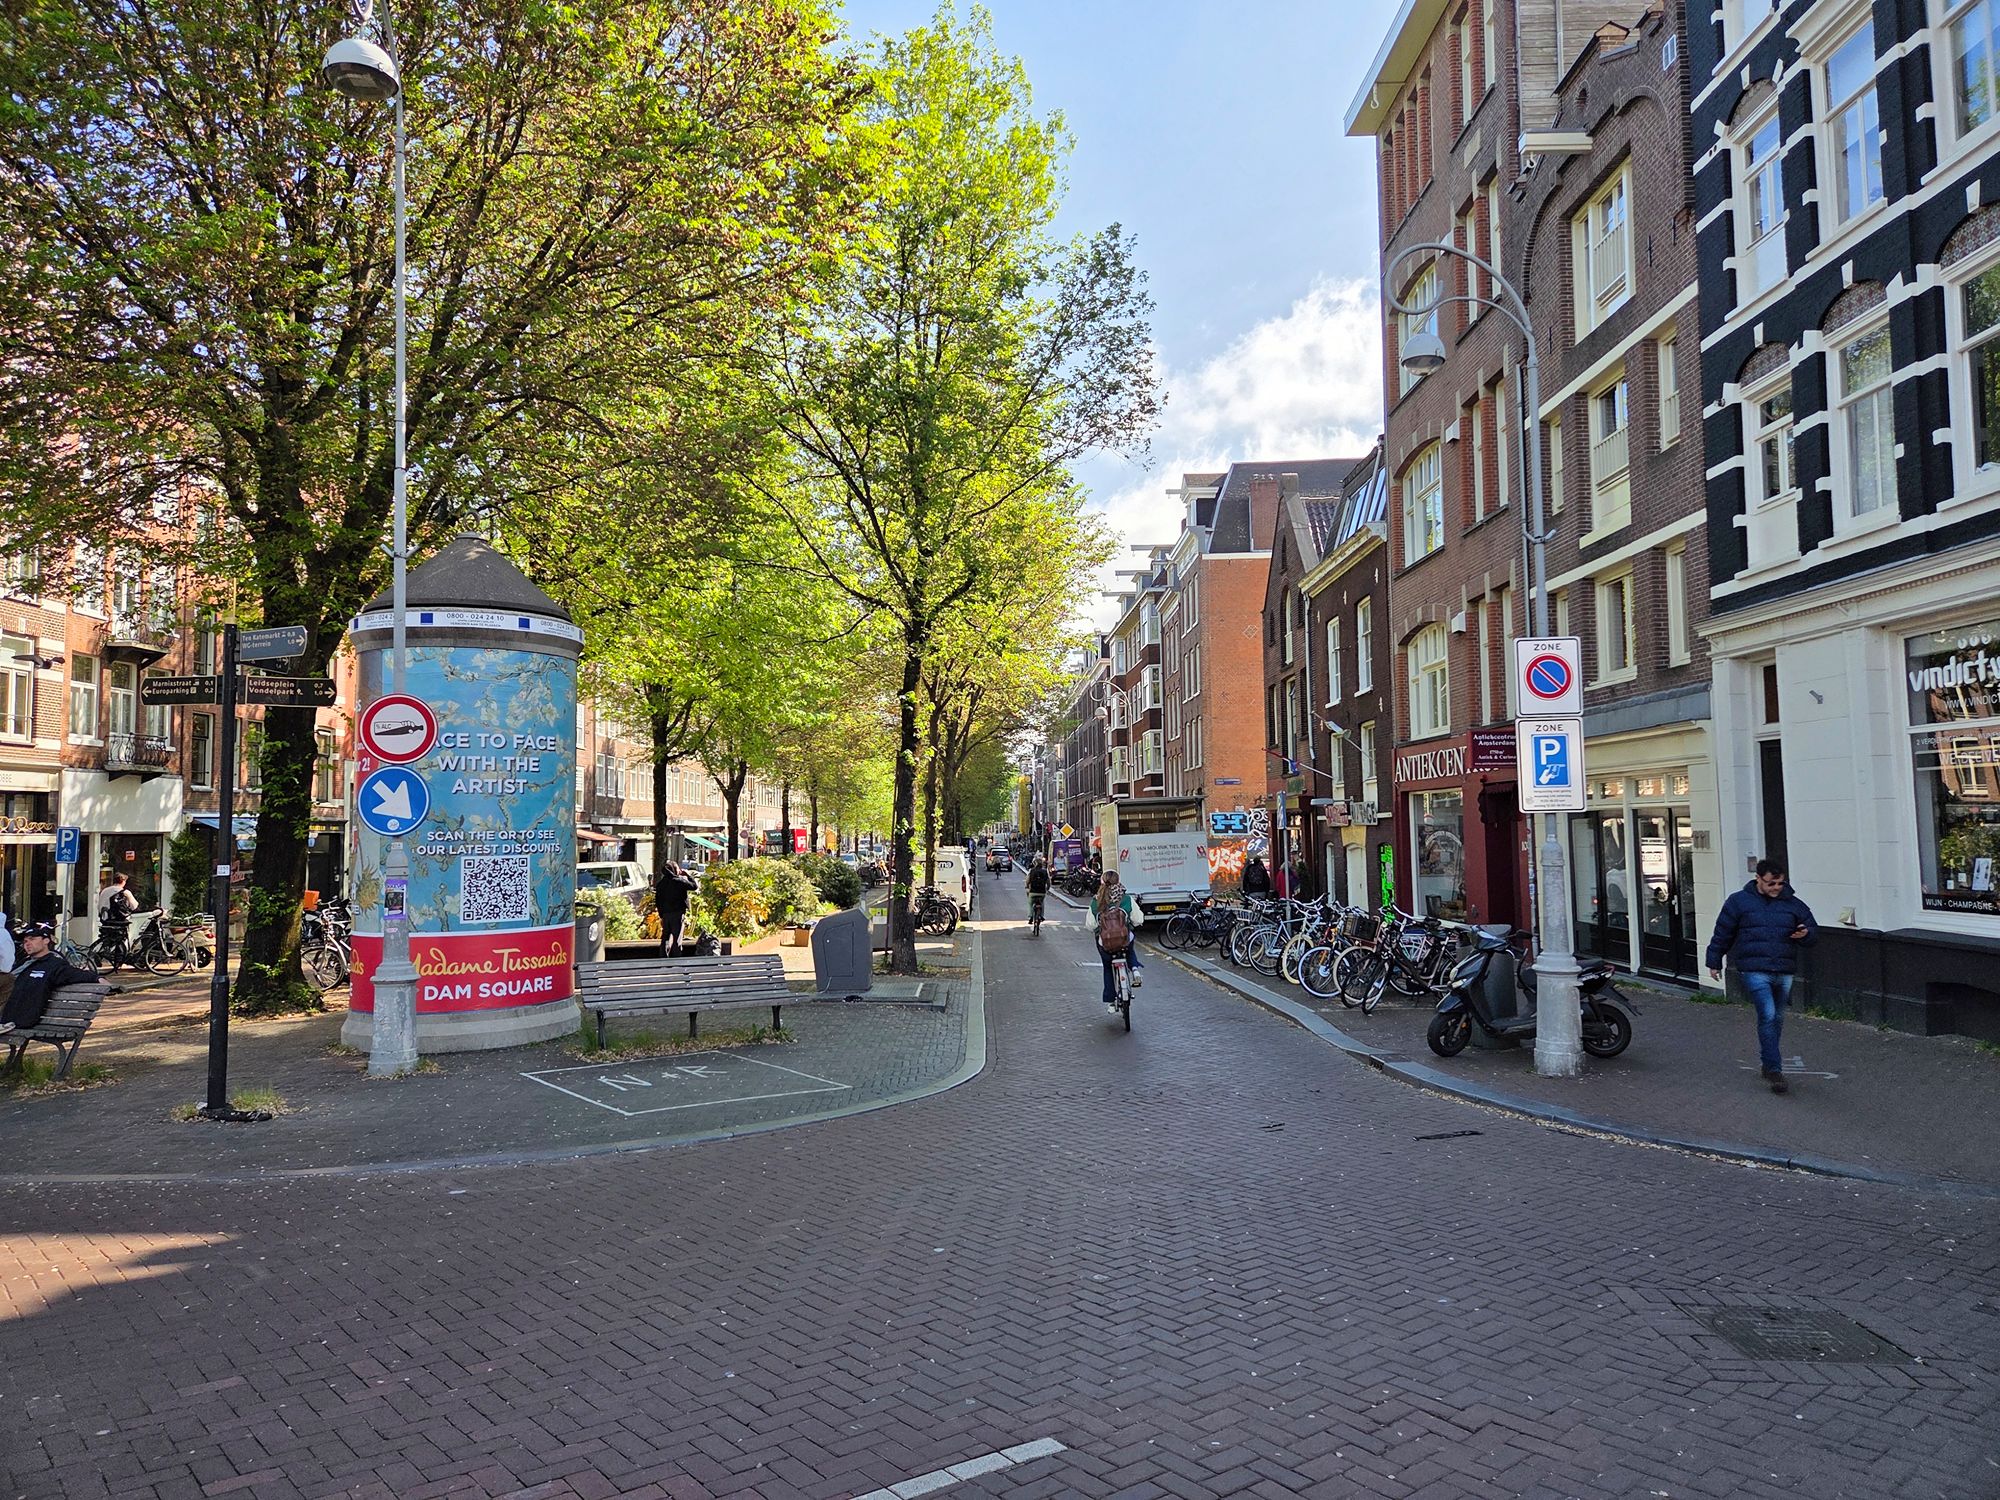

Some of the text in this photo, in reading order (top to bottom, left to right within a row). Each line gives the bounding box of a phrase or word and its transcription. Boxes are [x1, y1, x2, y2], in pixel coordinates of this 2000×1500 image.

[253, 632, 281, 640] Katemarkt
[1533, 643, 1562, 651] ZONE
[249, 680, 295, 688] Leidseplein
[249, 687, 295, 696] Vondelpark
[1535, 724, 1564, 732] ZONE
[477, 733, 507, 749] TO
[513, 733, 556, 751] FACE
[1540, 739, 1560, 765] P
[361, 757, 370, 771] 2!
[437, 756, 540, 772] WITH THE
[452, 779, 528, 795] ARTIST
[62, 831, 74, 847] P
[427, 830, 555, 842] SCAN THE QR TO SEE
[416, 845, 446, 856] OUR
[449, 845, 499, 855] LATEST
[501, 842, 561, 854] DISCOUNTS
[1948, 900, 1993, 911] CHAMPAGNE
[492, 941, 567, 974] Tussauds
[424, 976, 553, 1000] DAM SQUARE
